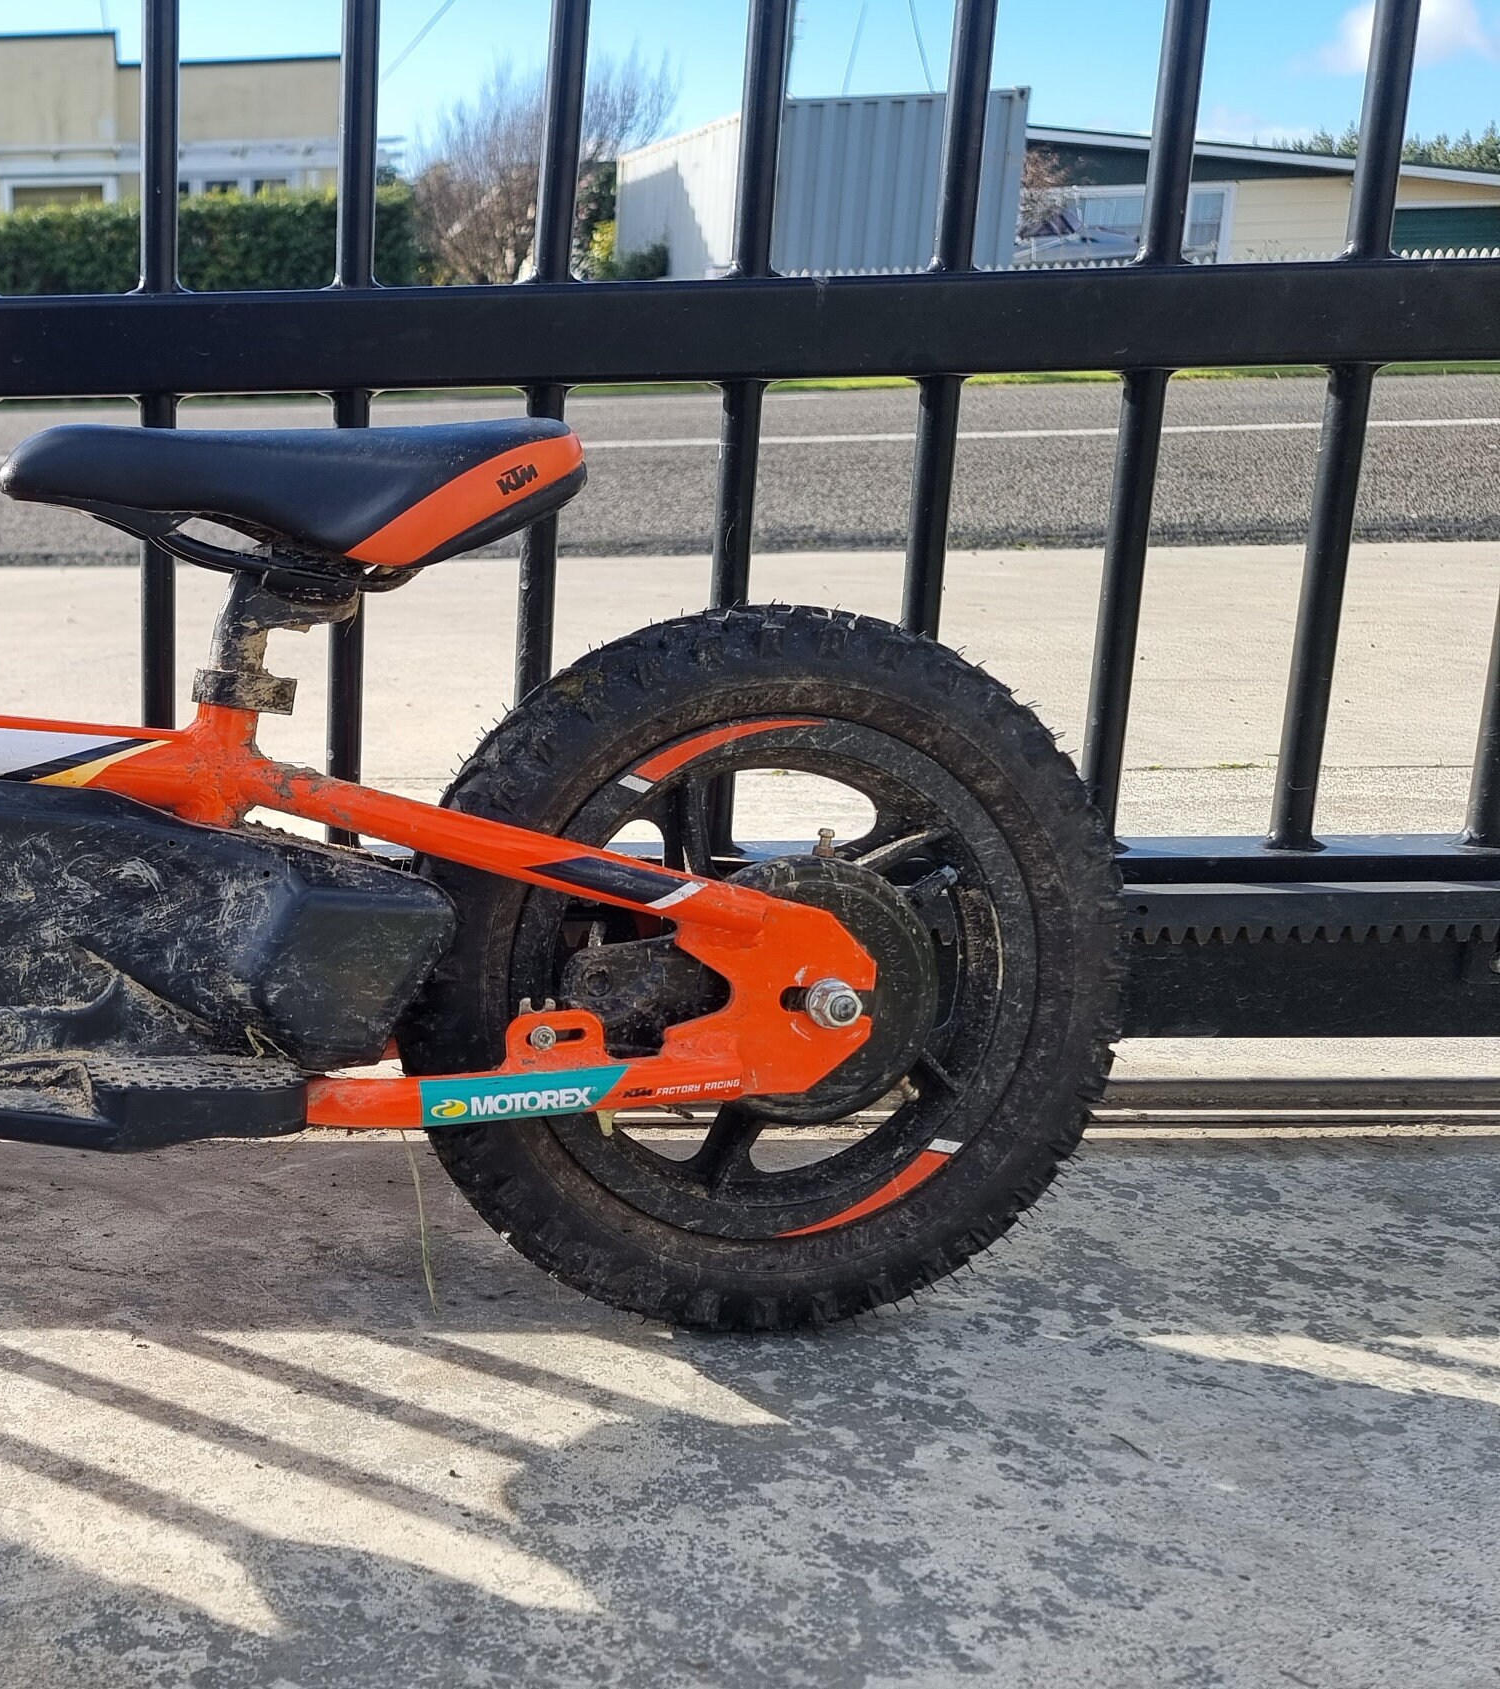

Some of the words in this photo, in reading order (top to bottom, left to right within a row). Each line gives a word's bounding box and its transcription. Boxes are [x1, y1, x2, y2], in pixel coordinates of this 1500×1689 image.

[496, 464, 538, 495] KTM
[470, 1086, 592, 1116] MOTOREX
[656, 1083, 701, 1096] FACTORY
[704, 1079, 740, 1092] RACING
